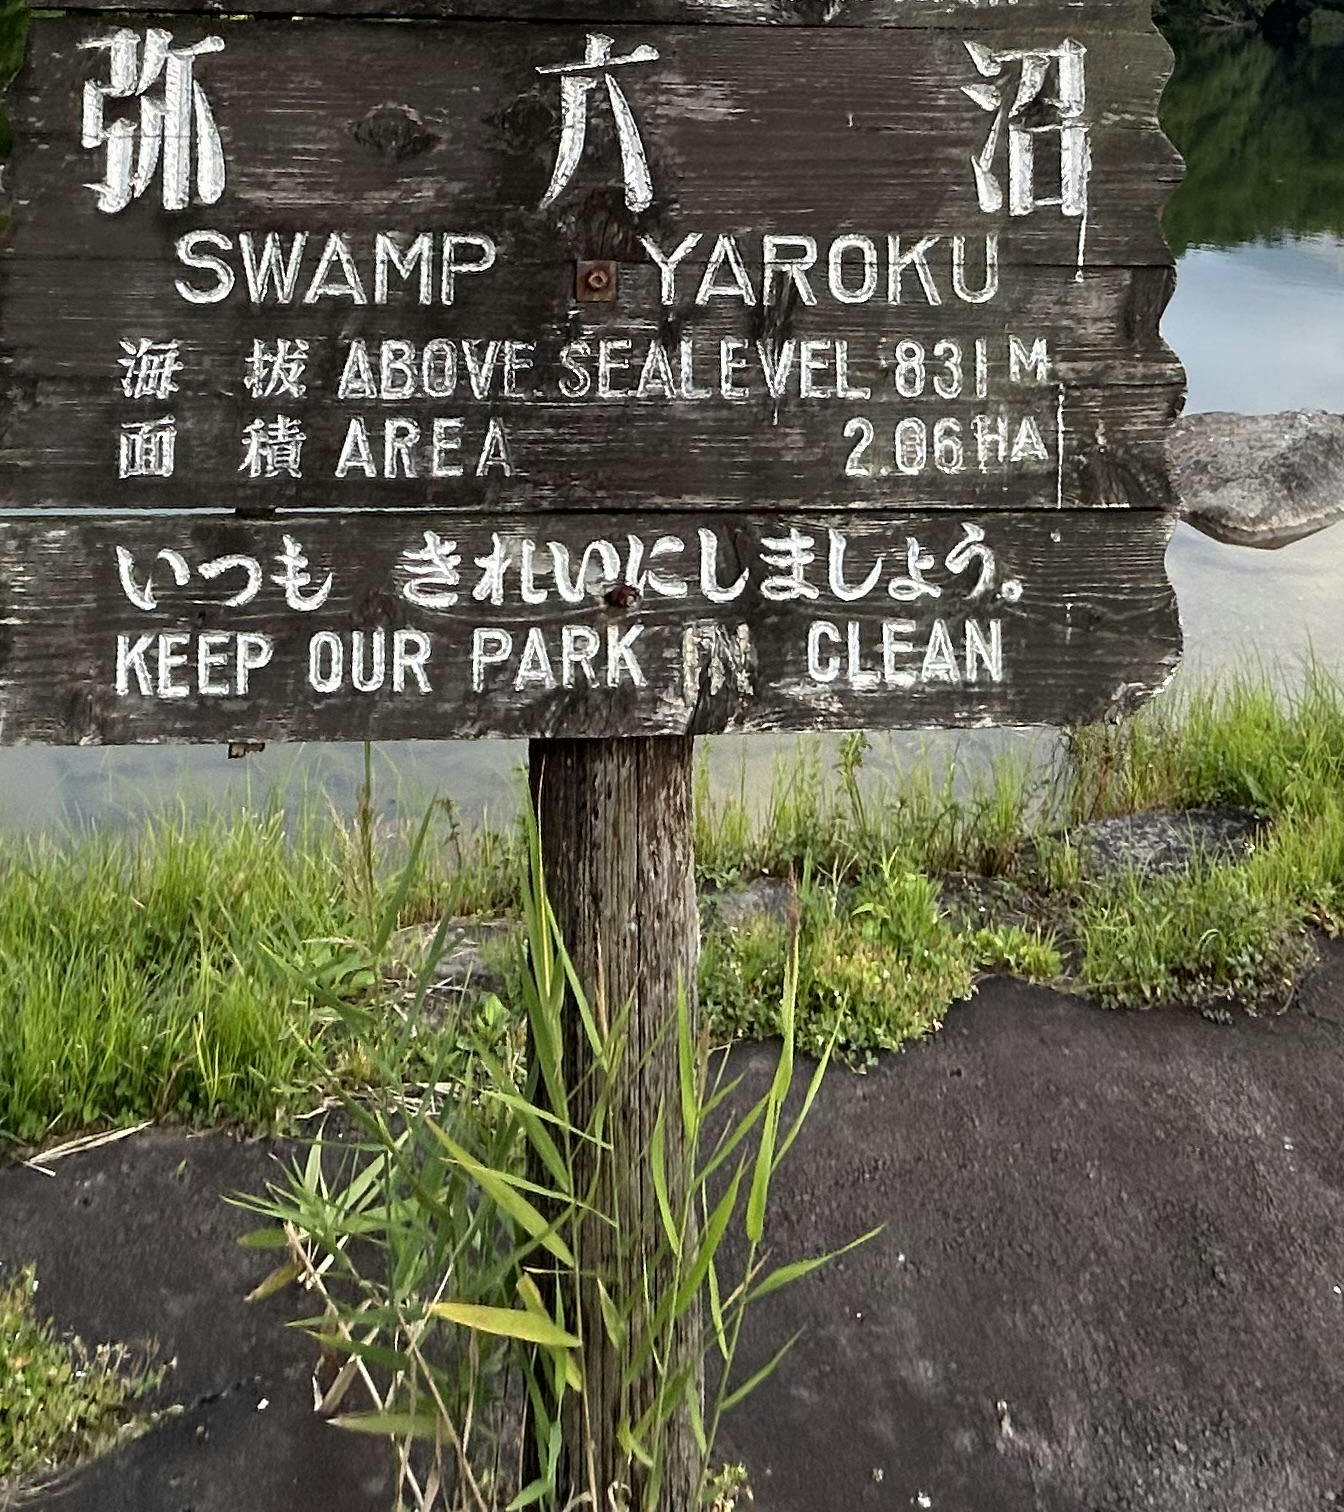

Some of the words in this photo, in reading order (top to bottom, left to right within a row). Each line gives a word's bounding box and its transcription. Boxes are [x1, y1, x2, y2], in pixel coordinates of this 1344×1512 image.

[174, 229, 497, 306] SWAMP
[638, 232, 1000, 307] YAROKU
[337, 337, 538, 401] ABOVE
[334, 416, 516, 479] AREA
[115, 533, 335, 612] いつも
[114, 629, 275, 698] KEEP
[307, 629, 434, 695] OUR
[471, 622, 649, 694] PARK
[806, 616, 1004, 688] CLEAN
